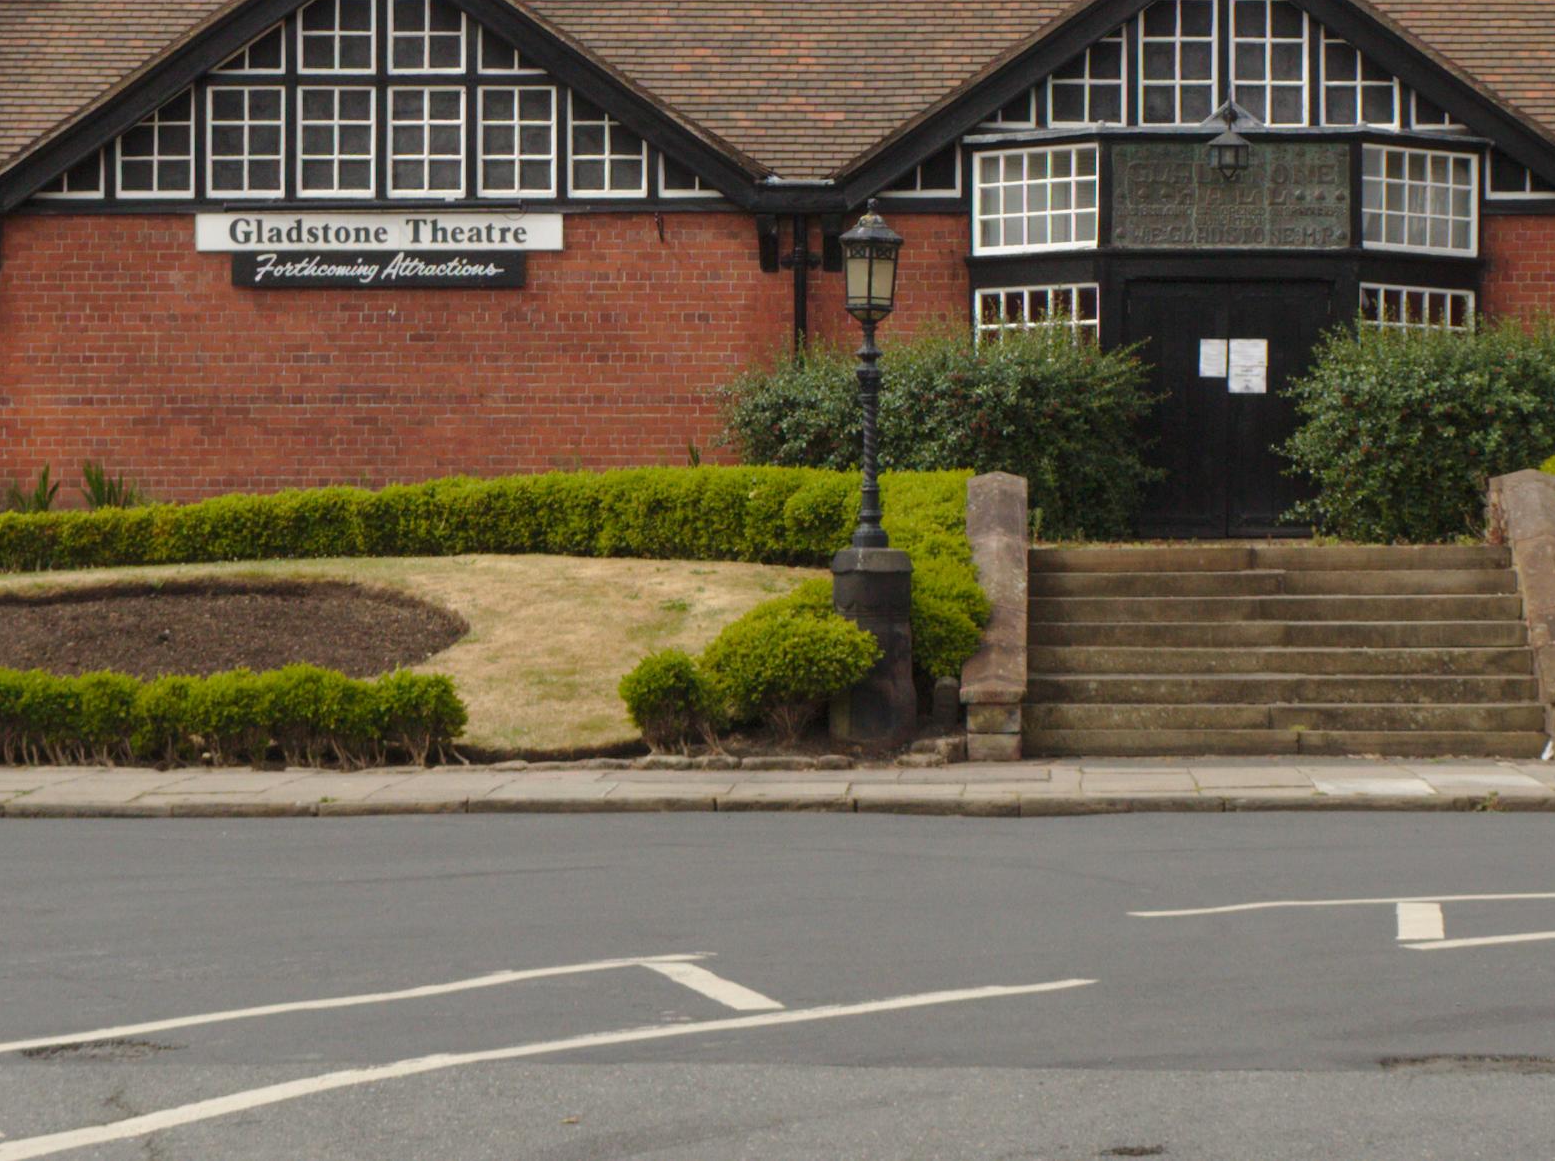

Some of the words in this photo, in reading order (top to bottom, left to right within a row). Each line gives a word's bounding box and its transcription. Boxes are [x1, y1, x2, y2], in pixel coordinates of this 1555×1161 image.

[229, 217, 388, 245] Gladstone
[405, 218, 527, 244] Theatre
[255, 253, 380, 283] Forthcoming
[381, 251, 504, 280] Attractions
